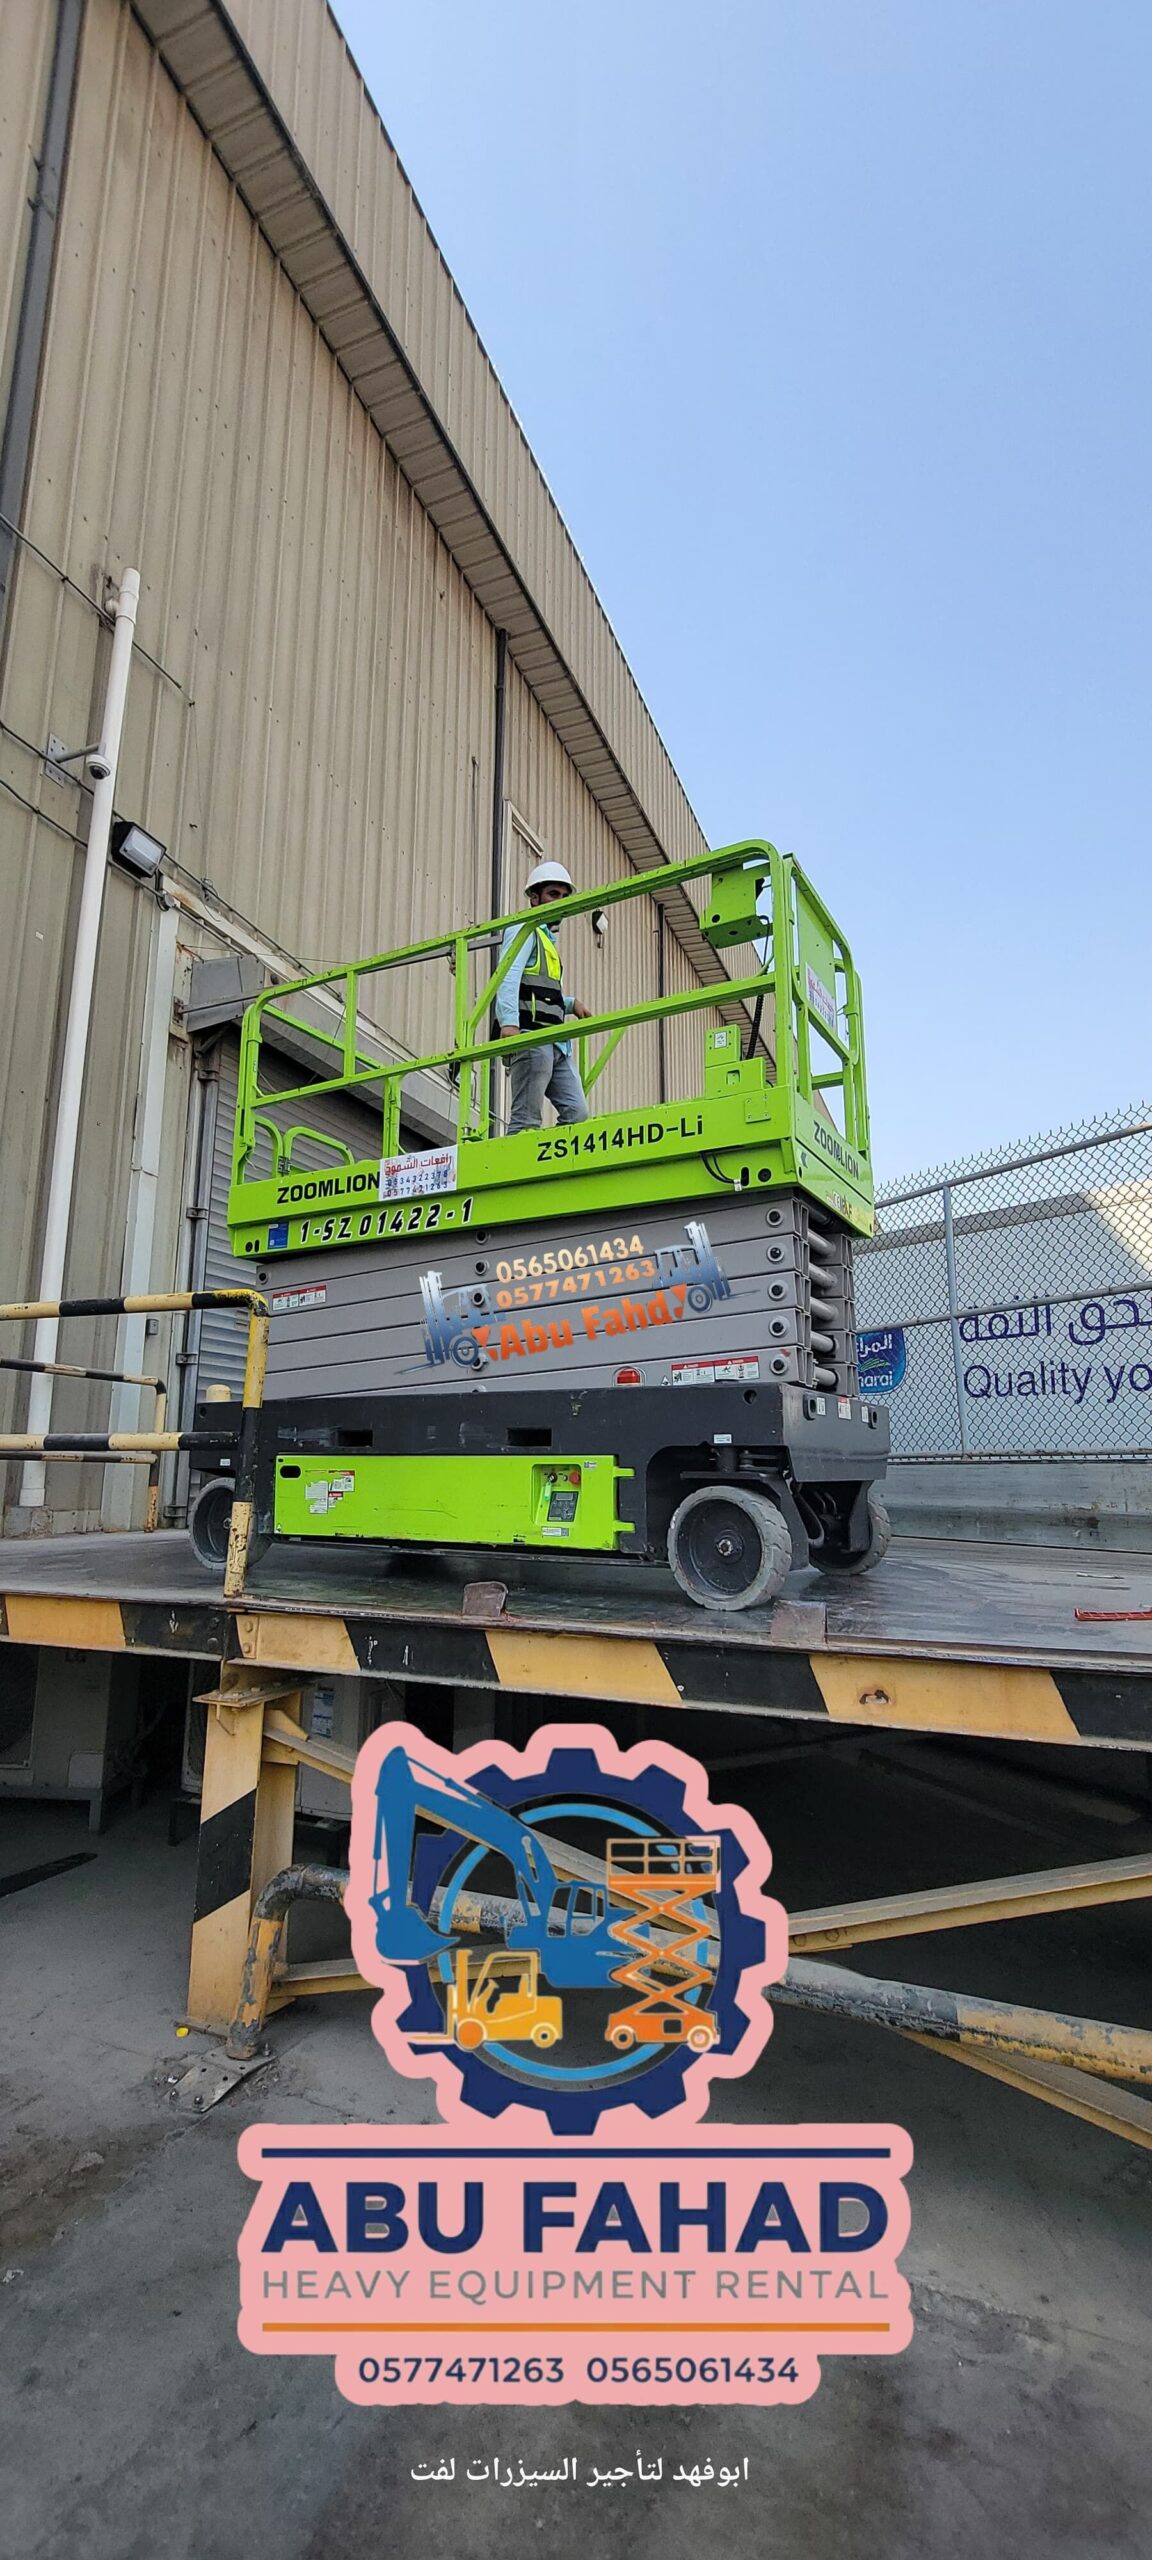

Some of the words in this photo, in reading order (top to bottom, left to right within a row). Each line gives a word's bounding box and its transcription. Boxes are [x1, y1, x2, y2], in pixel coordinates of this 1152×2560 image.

[536, 1115, 703, 1162] ZS1414HD-Li
[813, 1120, 859, 1180] ZOOMLION
[277, 1171, 380, 1204] ZOOMLION
[963, 1361, 1092, 1405] Quality
